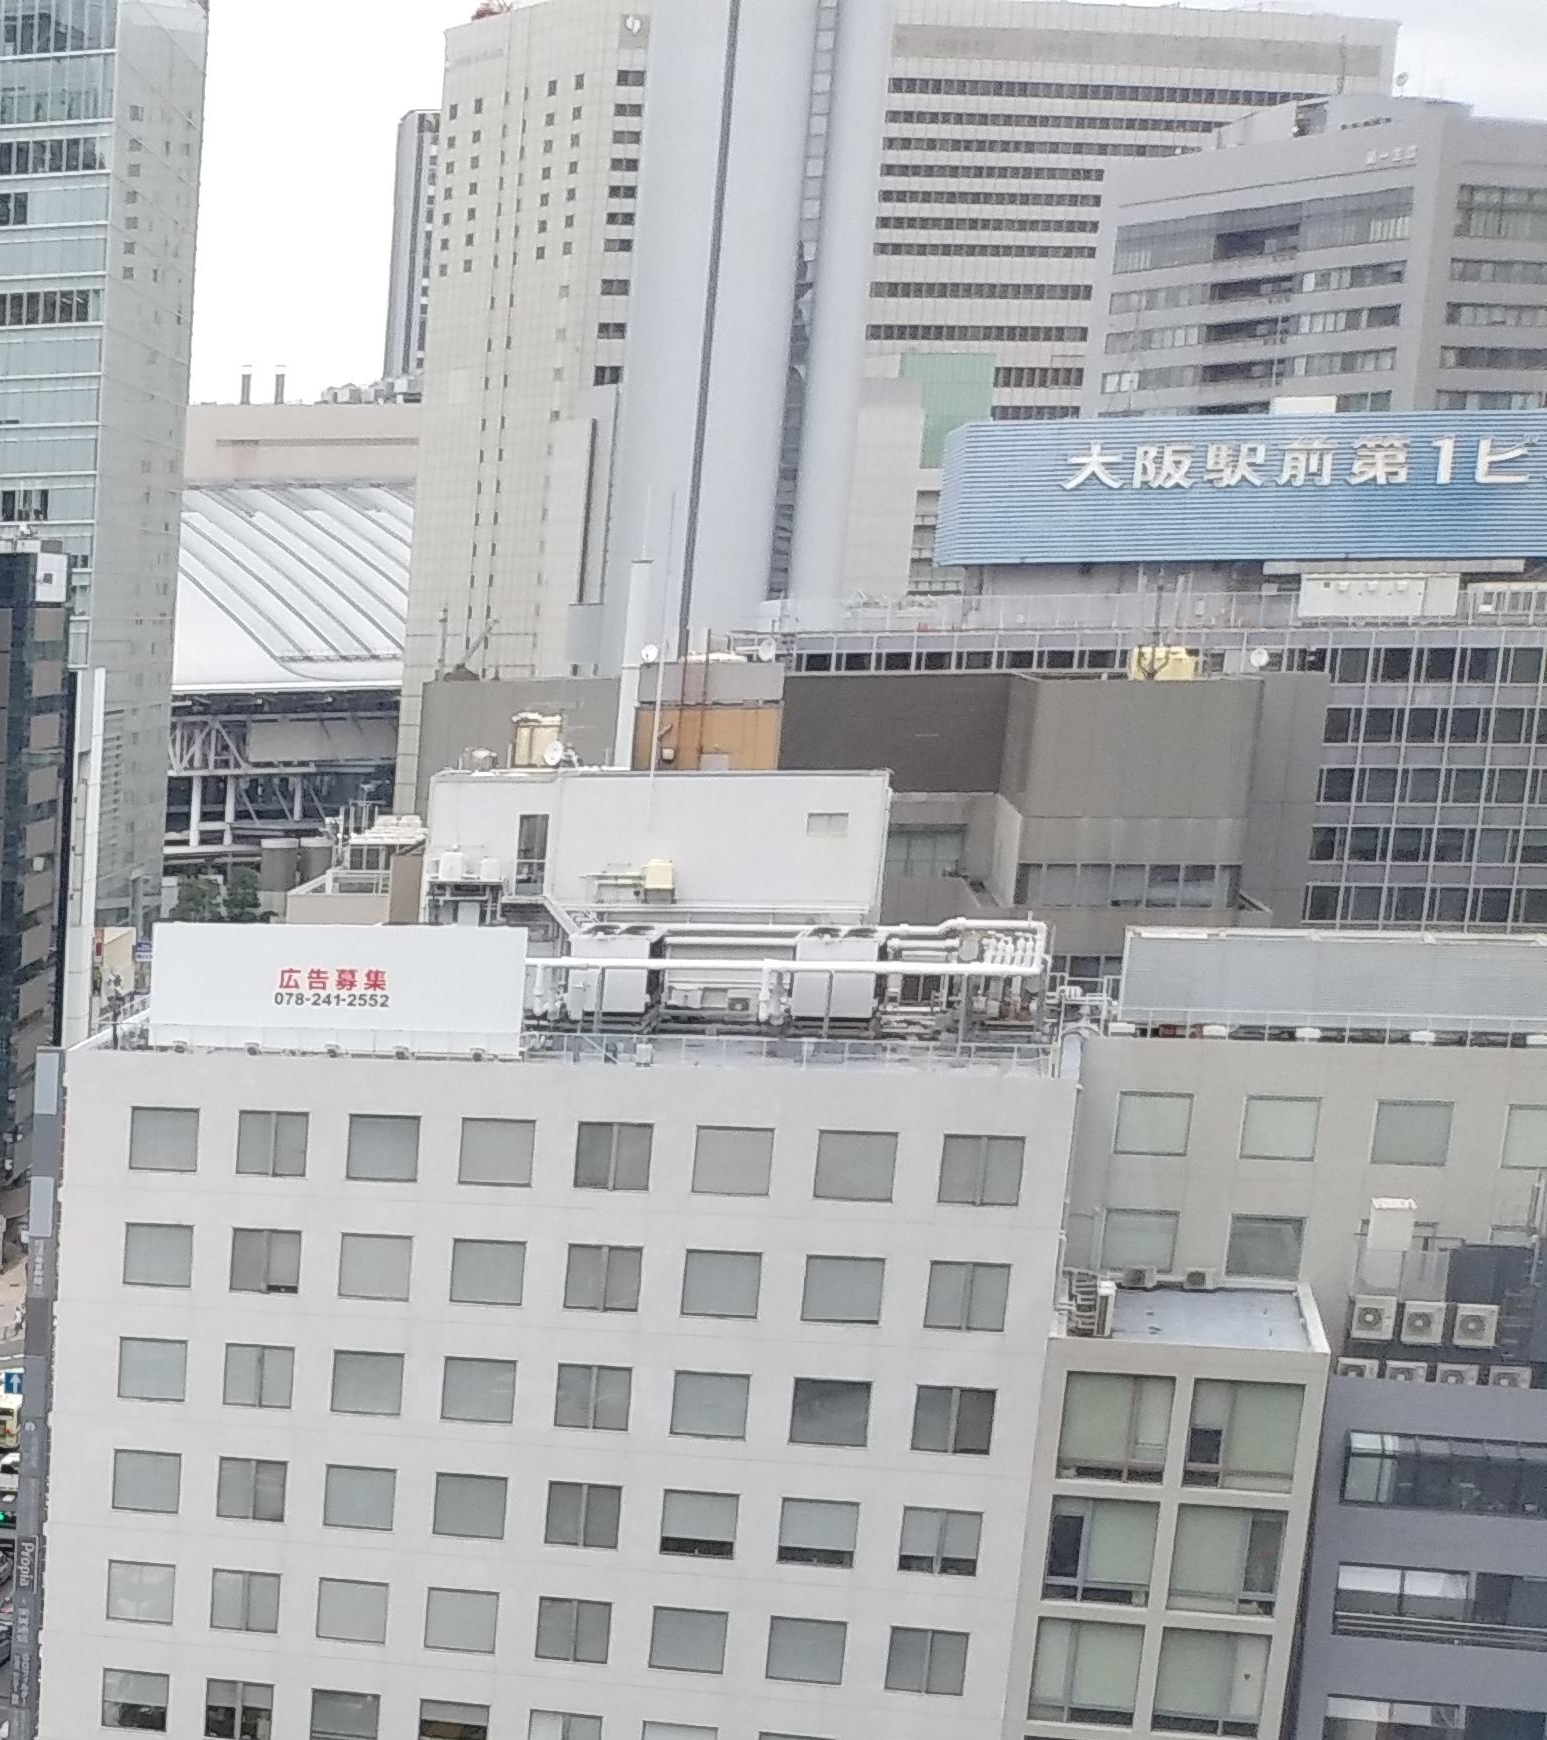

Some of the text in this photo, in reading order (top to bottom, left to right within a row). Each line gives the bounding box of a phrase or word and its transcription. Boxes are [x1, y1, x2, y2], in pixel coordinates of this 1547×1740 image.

[1059, 435, 1547, 489] 大阪駅前第1ビ
[278, 968, 387, 991] 広告募集
[274, 992, 389, 1008] 078-241-2552
